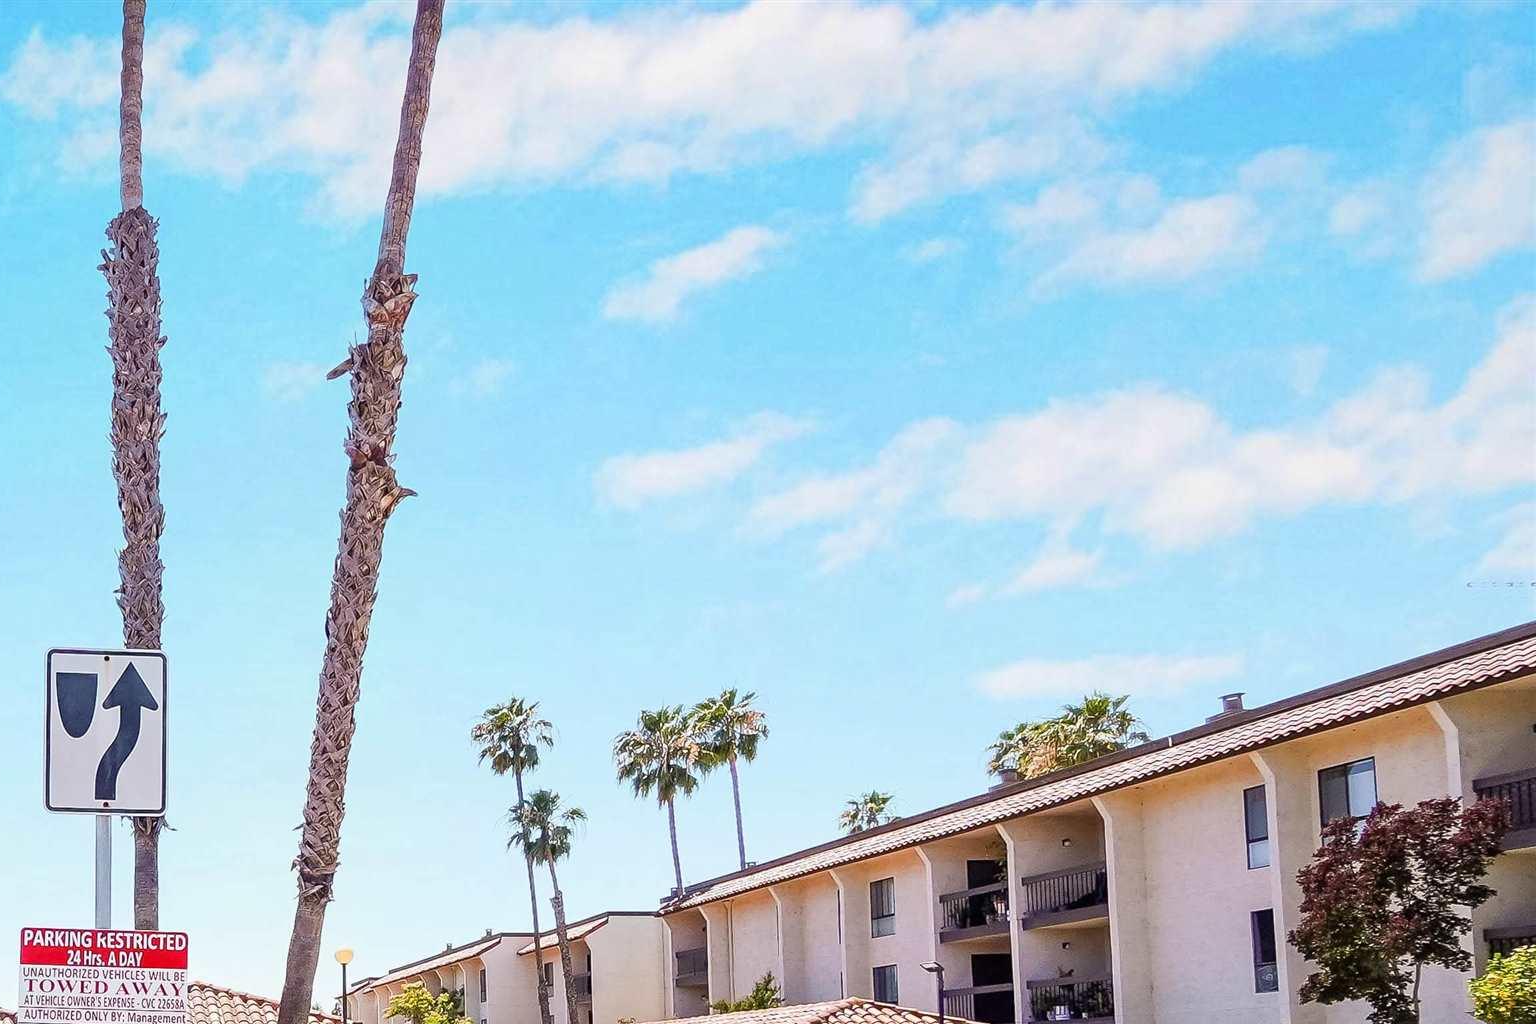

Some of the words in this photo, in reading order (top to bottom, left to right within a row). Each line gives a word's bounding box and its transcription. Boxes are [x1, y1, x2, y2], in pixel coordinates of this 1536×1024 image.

[23, 930, 92, 948] PARKING
[96, 931, 187, 951] RESTRICTED
[66, 950, 81, 965] 24
[83, 950, 106, 966] Hrs.
[108, 952, 117, 966] A
[119, 952, 144, 967] DAY
[23, 967, 100, 979] UNAUTHORIZED
[102, 970, 146, 980] VEHICLES
[149, 971, 171, 981] WILL
[173, 972, 185, 982] BE
[24, 979, 109, 994] TOWED
[116, 982, 185, 997] AWAY
[24, 995, 34, 1005] AT
[35, 995, 65, 1006] VEHICLE
[67, 996, 102, 1007] OWNER'S
[103, 997, 135, 1008] EXPENSE
[141, 998, 156, 1009] CVC
[157, 999, 185, 1010] 22658A
[24, 1009, 82, 1021] AUTHORIZED
[84, 1011, 109, 1022] ONLY
[128, 1012, 186, 1024] Management
